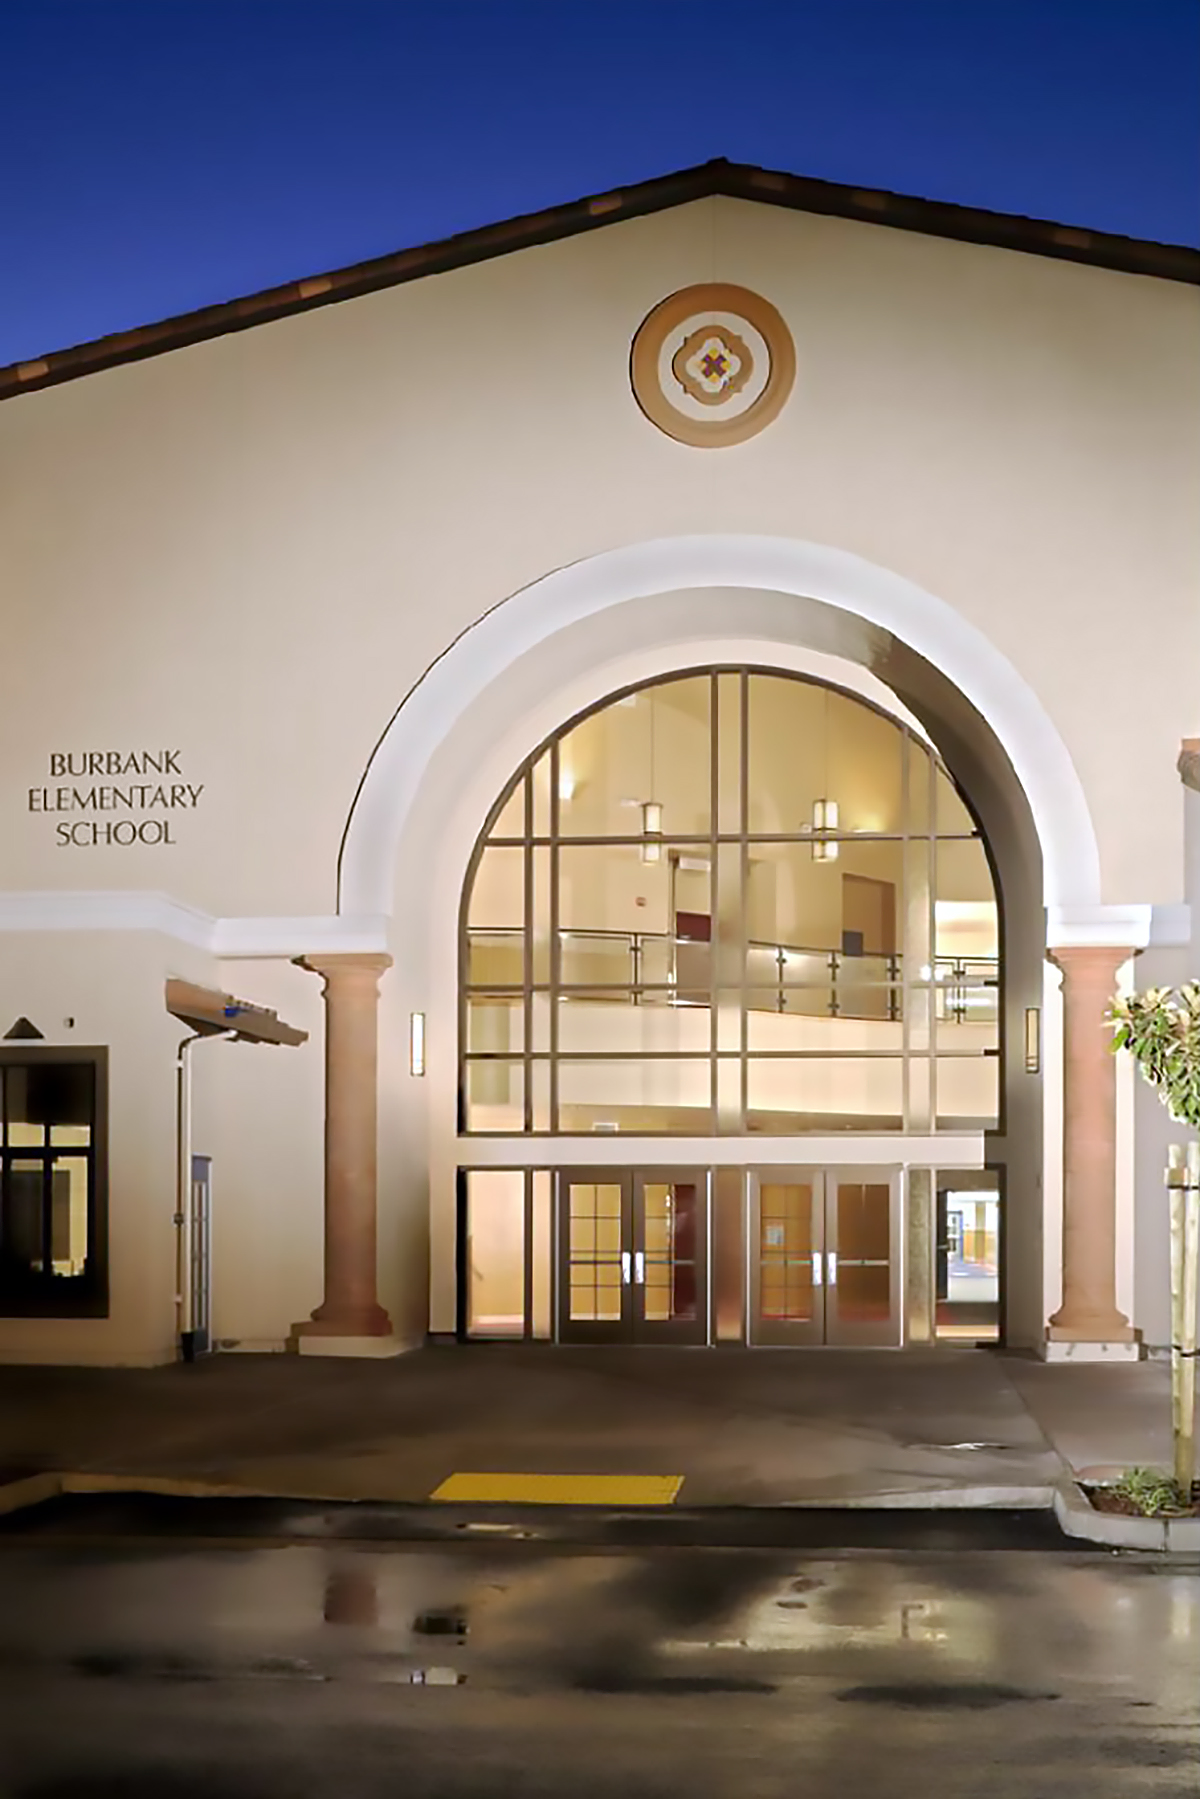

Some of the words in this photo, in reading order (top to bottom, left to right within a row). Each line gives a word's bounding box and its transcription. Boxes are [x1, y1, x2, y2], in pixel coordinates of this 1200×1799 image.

[50, 750, 182, 777] BURBANK
[28, 784, 204, 812] ELEMENTARY
[56, 820, 176, 846] SCHOOL
